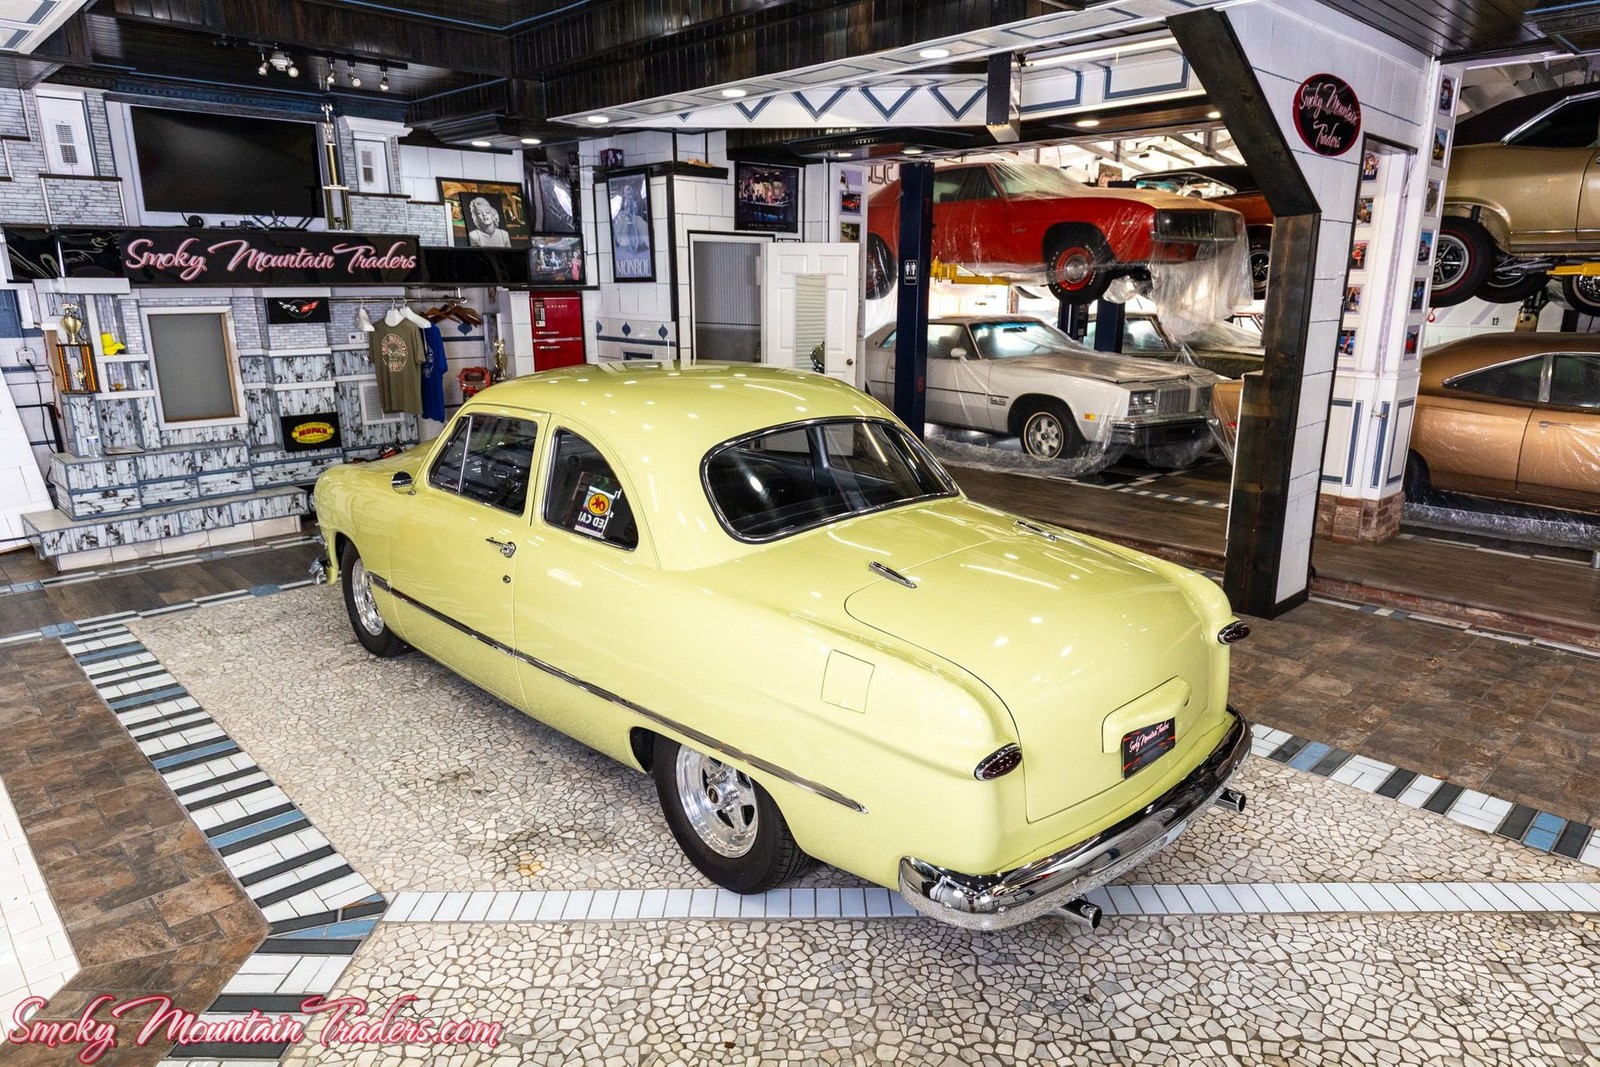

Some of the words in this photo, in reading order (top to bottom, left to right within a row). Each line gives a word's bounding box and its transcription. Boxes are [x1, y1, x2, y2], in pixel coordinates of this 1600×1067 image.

[1299, 82, 1323, 119] Smoky
[1323, 83, 1358, 126] Mountain
[1312, 120, 1342, 149] Traders
[125, 237, 207, 282] Smoky
[207, 239, 336, 272] Mountain
[332, 241, 417, 274] Traders
[298, 427, 328, 438] MOPAR
